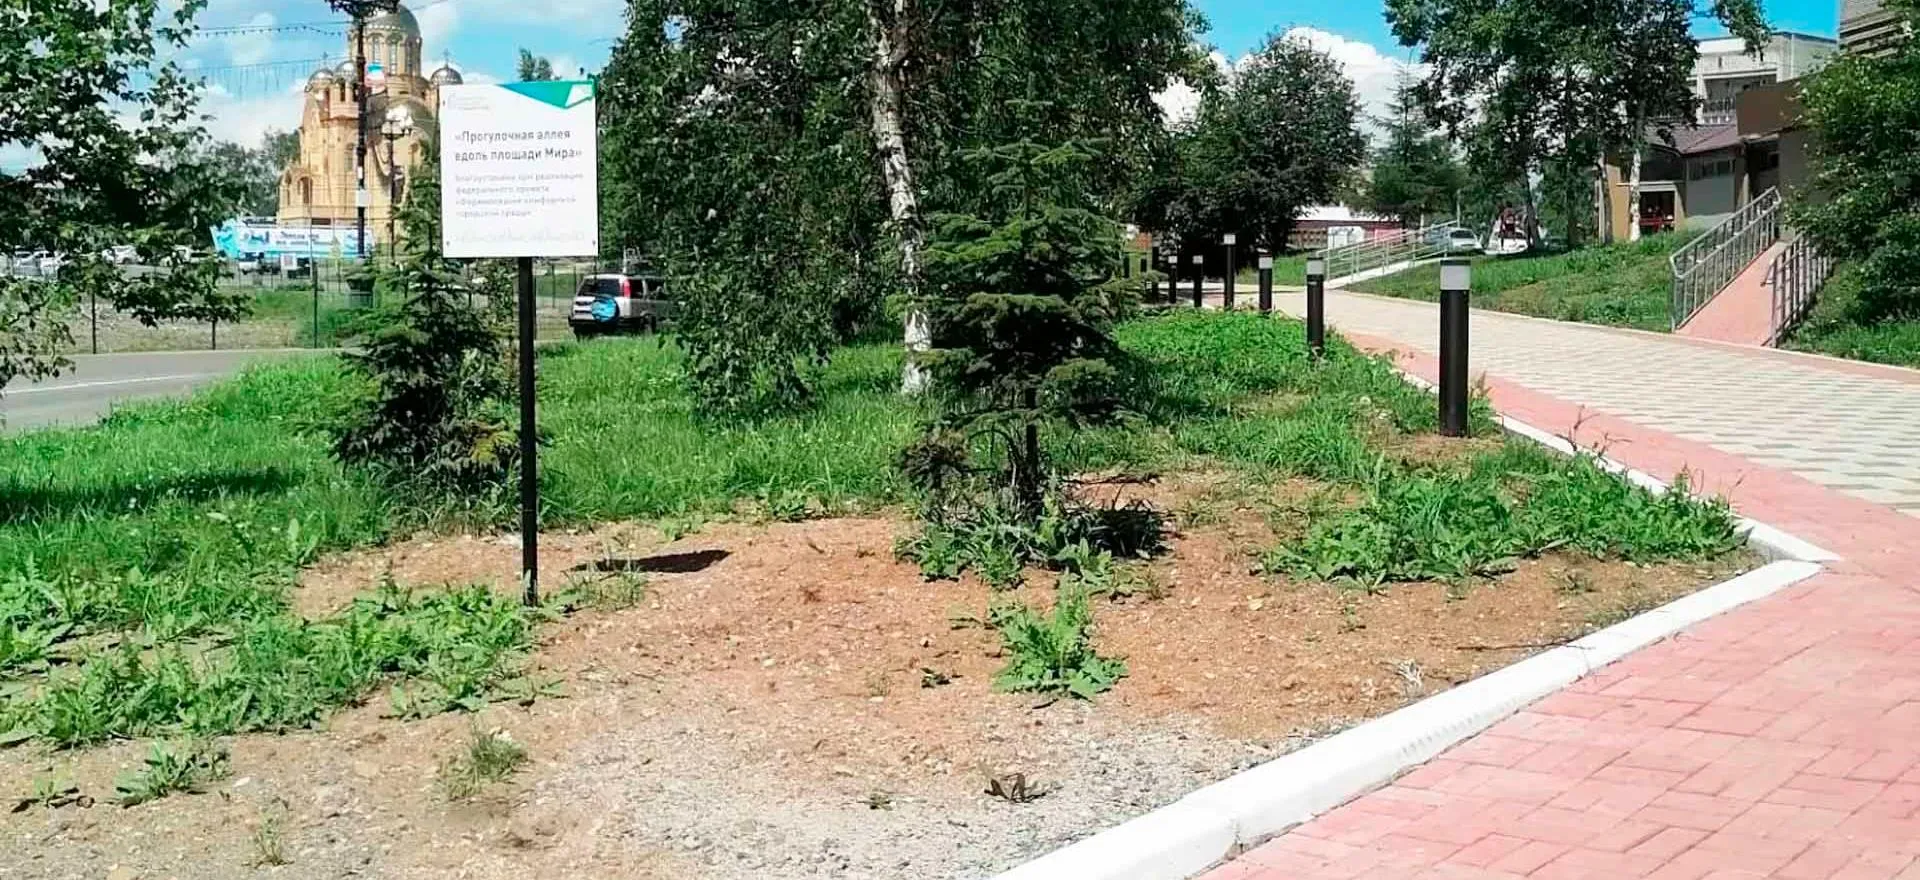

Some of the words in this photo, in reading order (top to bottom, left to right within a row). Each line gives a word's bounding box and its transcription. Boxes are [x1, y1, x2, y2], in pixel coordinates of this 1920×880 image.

[455, 130, 534, 144] «Прогулочная
[537, 130, 571, 140] аллея
[455, 150, 488, 161] вдоль
[491, 149, 541, 161] площади
